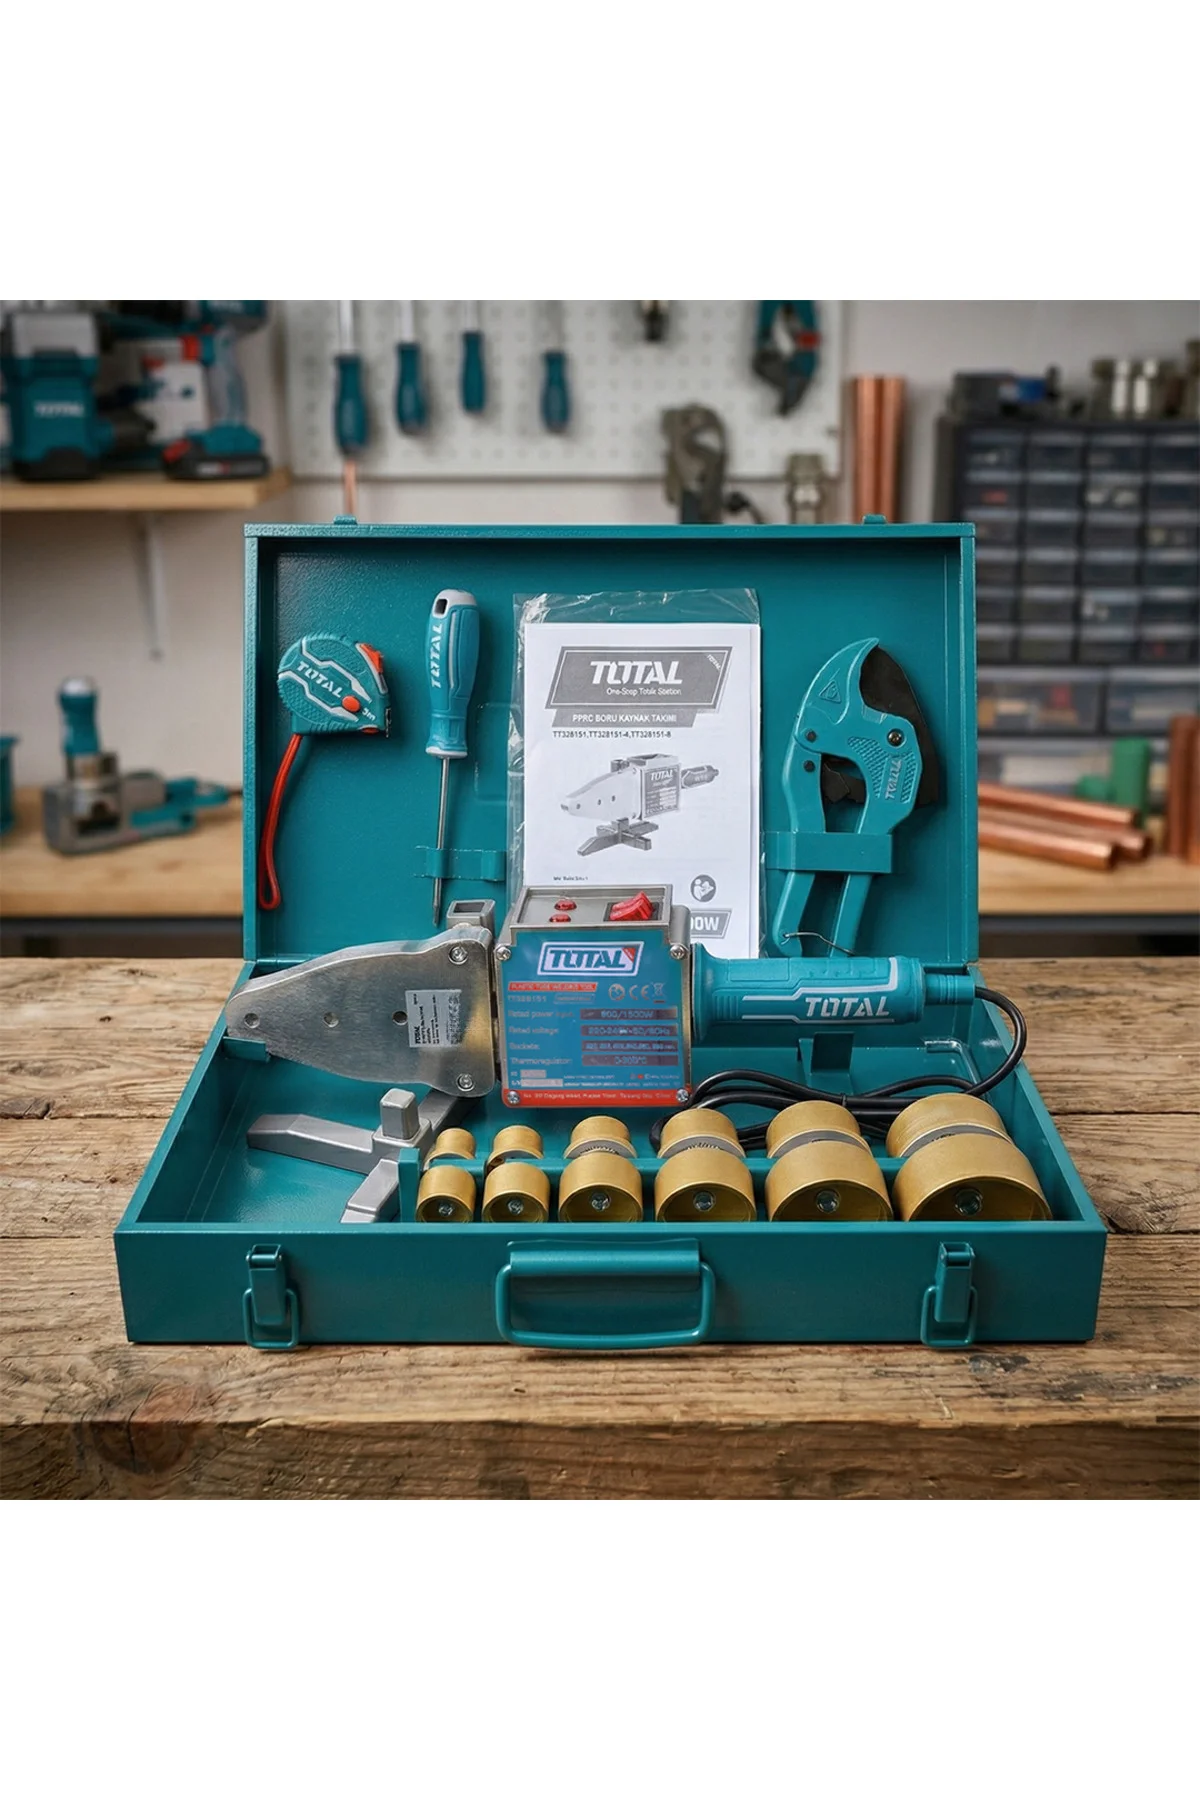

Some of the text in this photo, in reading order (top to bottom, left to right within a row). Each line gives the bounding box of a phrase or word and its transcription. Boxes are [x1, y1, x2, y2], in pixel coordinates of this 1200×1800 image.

[430, 623, 443, 689] TOTAL
[297, 660, 344, 698] TOTAL
[590, 661, 683, 685] TOTAL
[572, 714, 594, 723] PPRC
[595, 714, 618, 723] BORU
[618, 714, 650, 723] KAYNAK
[650, 769, 674, 782] TOTAL
[549, 949, 626, 969] TOTAL
[805, 995, 890, 1018] TOTAL
